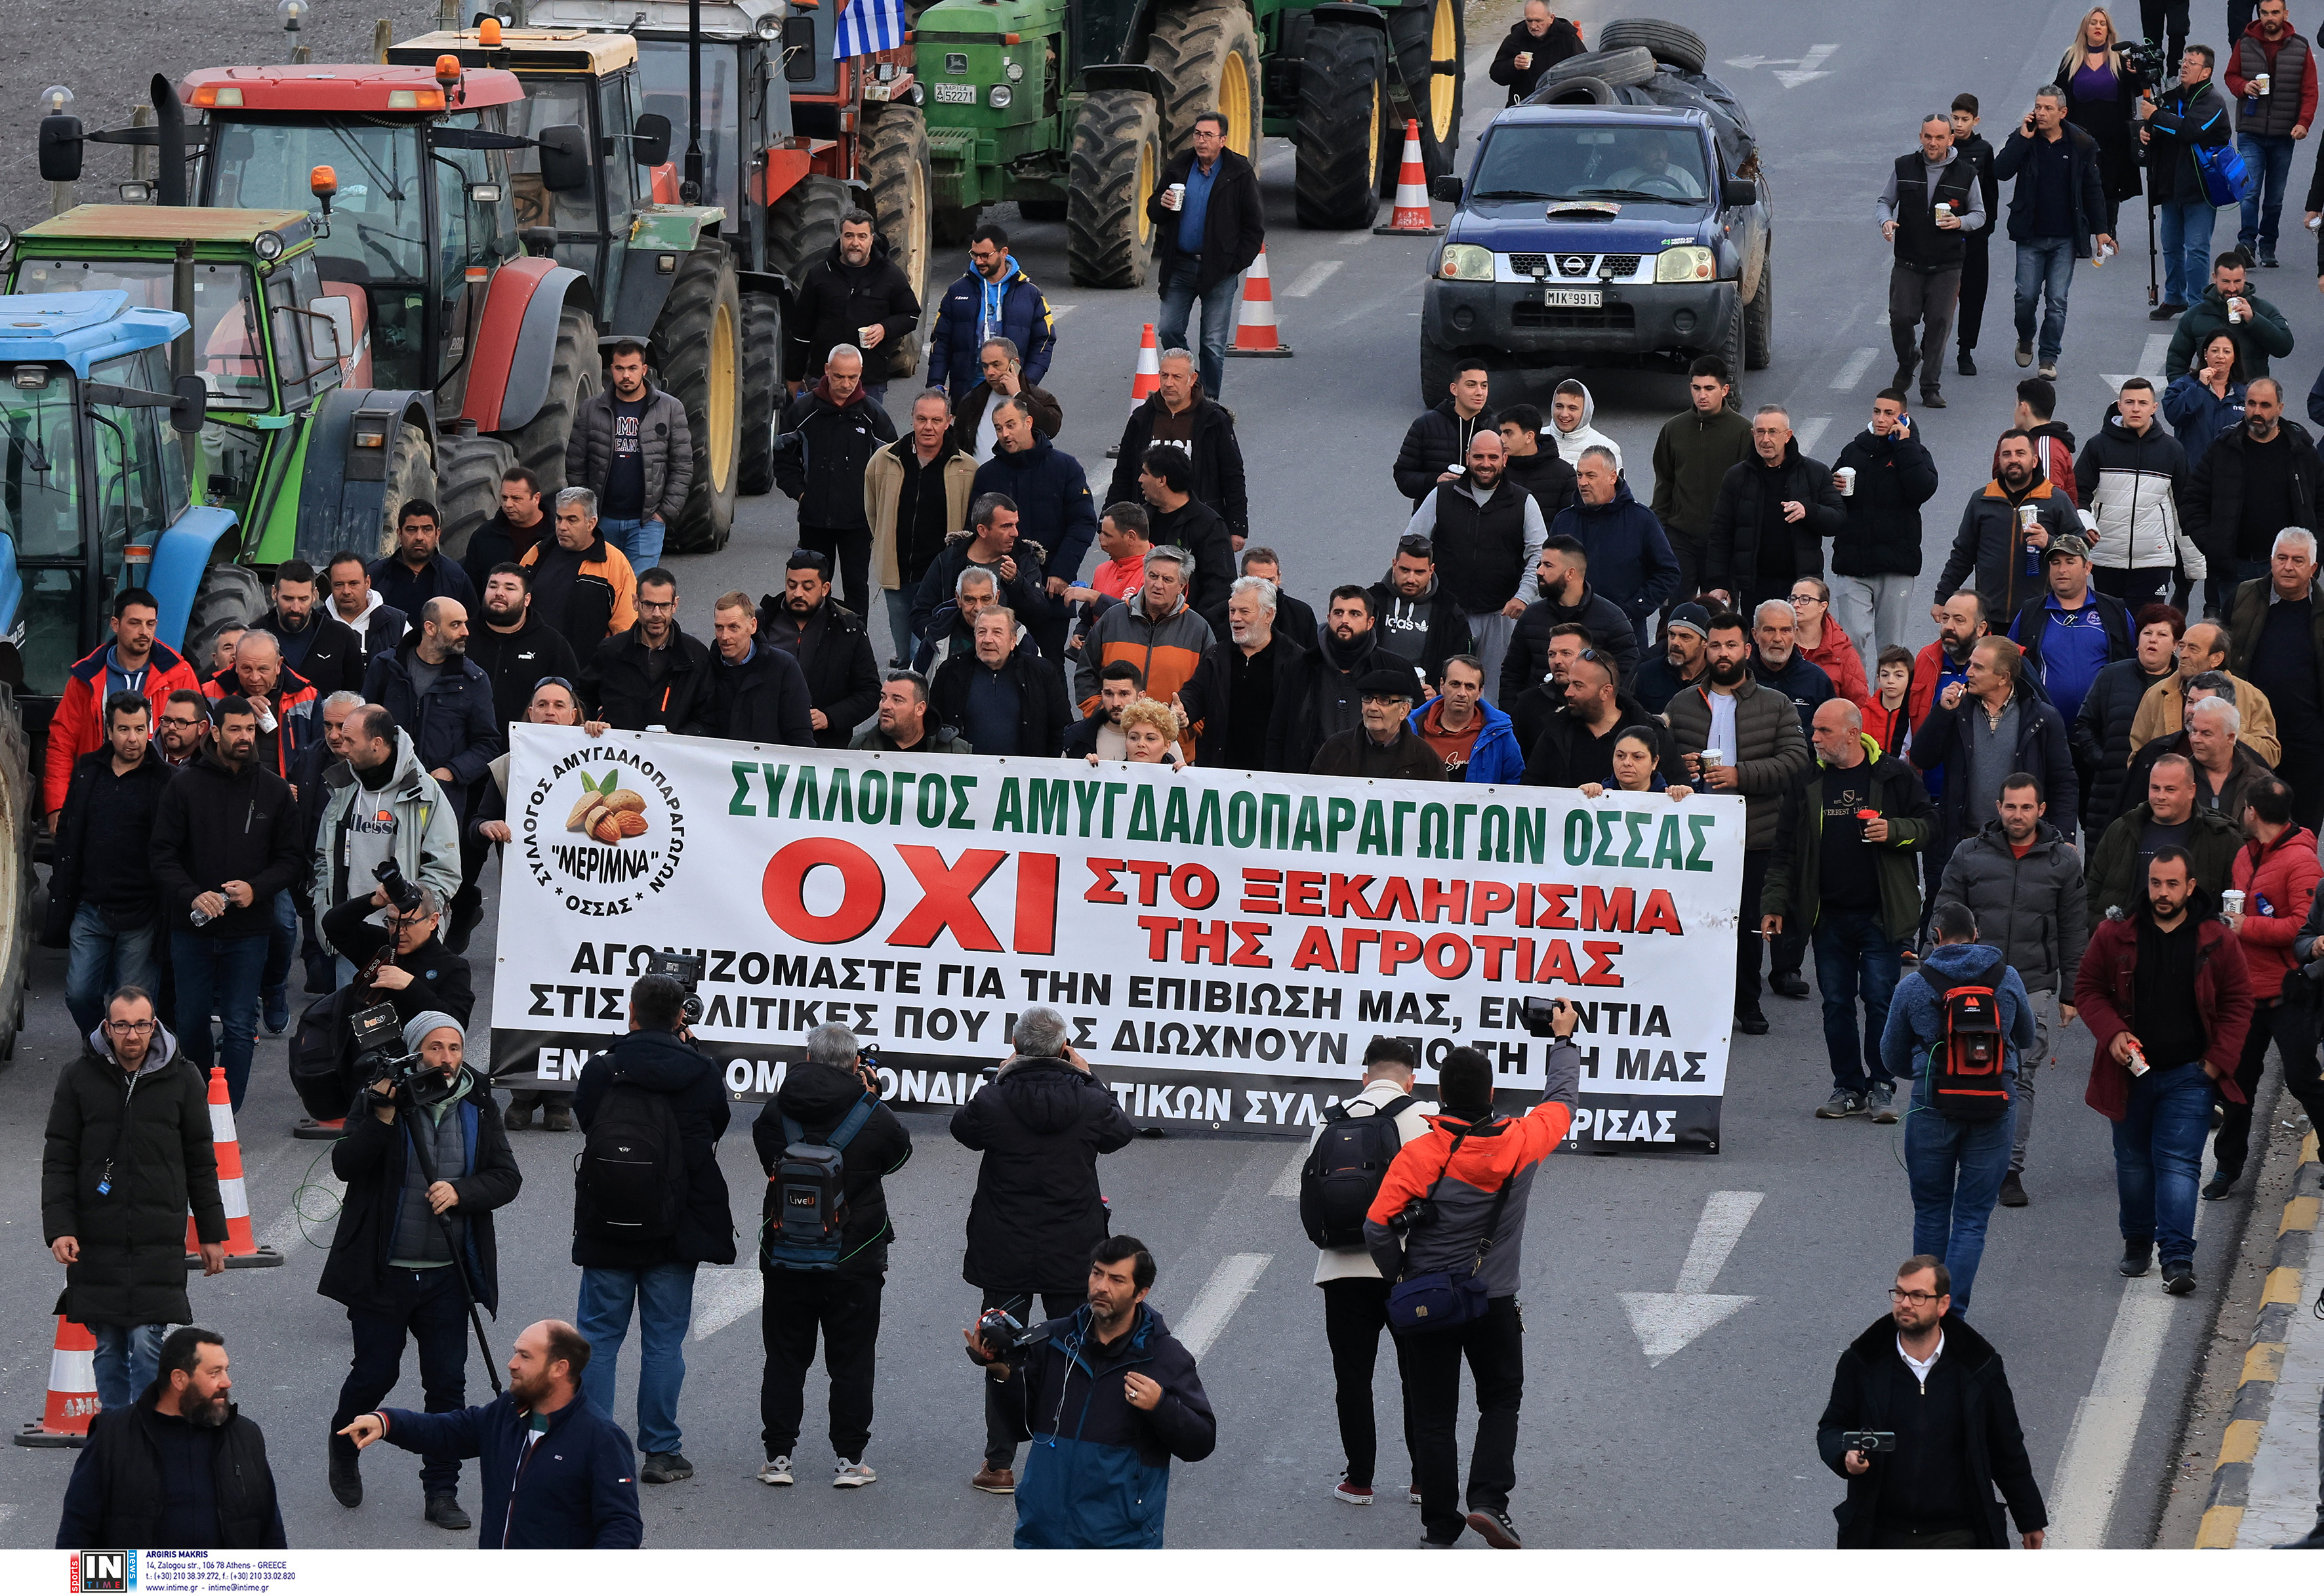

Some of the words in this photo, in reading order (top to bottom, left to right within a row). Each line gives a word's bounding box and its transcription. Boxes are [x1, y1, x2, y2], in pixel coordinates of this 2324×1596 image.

[945, 91, 972, 102] 52271
[523, 777, 553, 887] ΣΥΛΛΟΓΟΣ
[552, 747, 685, 893] ΑΜΥΓΔΑΛΟΠΑΡΑΓΩΓΩΝ
[728, 761, 978, 830] ΣΥΛΛΟΓΟΣ
[992, 776, 1547, 865] ΑΜΥΓΔΑΛΟΠΑΡΑΓΩΓΩΝ
[1562, 808, 1716, 872] ΟΣΣΑΣ
[1823, 808, 1850, 817] VERBEST
[552, 845, 659, 884] "ΜΕΡΙΜΝΑ"
[762, 836, 1061, 957] ΟΧΙ
[1083, 856, 1221, 911] ΣΤΟ
[1240, 867, 1684, 936] ΞΕΚΛΗΡΙΣΜΑ
[565, 895, 633, 917] ΟΣΣΑΣ
[569, 941, 922, 994] ΑΓΩΙΖΟΜΑΣΤΕ
[937, 964, 1006, 1000] ΓΙΑ
[1020, 969, 1112, 1006] ΤΗΝ
[1128, 975, 1342, 1021] ΕΠΙΒΙΩΣΗ
[1357, 989, 1463, 1034] ΜΑΣ,
[1478, 996, 1672, 1038] ΕΝΝΤΙΑ
[1137, 915, 1274, 969] ΤΗΣ
[1290, 924, 1625, 988] ΑΓΡΟΤΙΑΣ
[527, 983, 625, 1021] ΣΤΙΣ
[703, 994, 879, 1036] ΛΙΤΙΚΕΣ
[893, 1005, 990, 1043] ΠΟΥ
[1111, 1019, 1348, 1065] ΔΙΩΧΝΟΥΝ
[1616, 1049, 1707, 1082] ΜΑΣ
